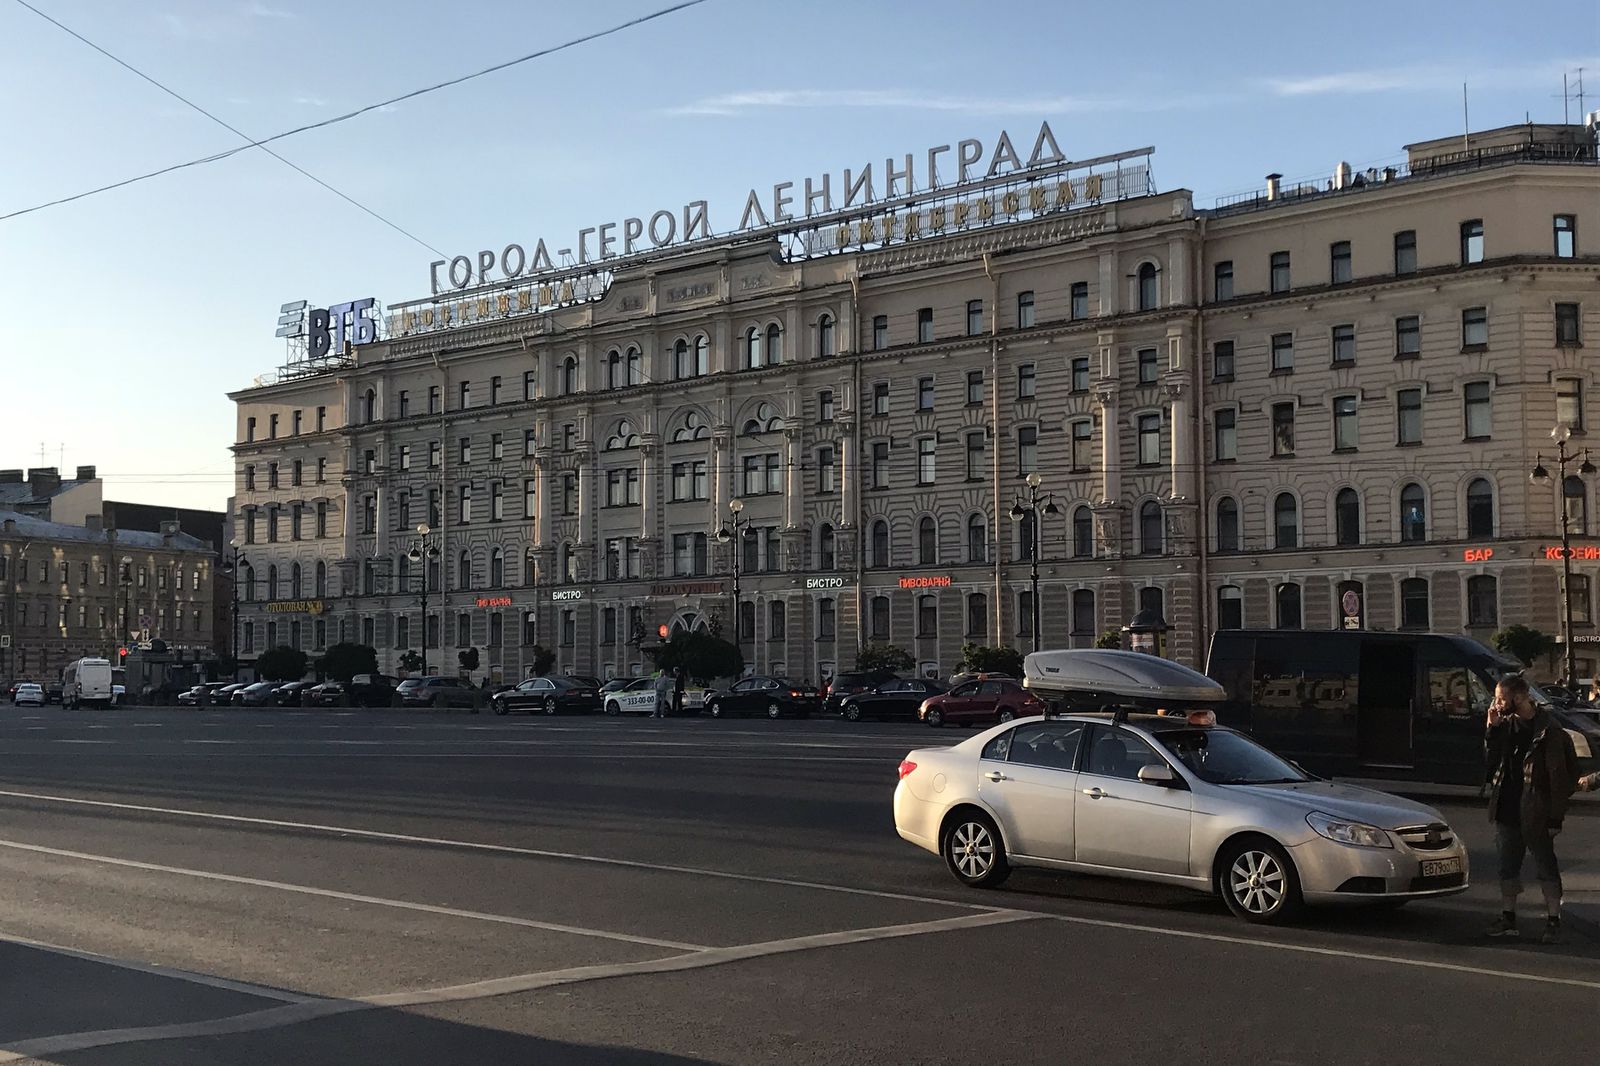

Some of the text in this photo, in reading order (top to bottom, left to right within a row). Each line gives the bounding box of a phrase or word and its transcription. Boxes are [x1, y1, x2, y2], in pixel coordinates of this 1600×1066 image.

[430, 121, 1068, 294] ГОРОД-ГЕРОЙ ЛЕНИНГРАД
[404, 174, 1103, 330] ГОСТИНИЦА ОКТЯБРЬСКАЯ
[308, 297, 375, 358] ВТБ
[1464, 548, 1494, 562] БАР
[806, 577, 843, 588] БИСТРО
[899, 576, 951, 588] ПИВОВАРНЯ
[552, 590, 581, 600] БИСТРО
[475, 597, 512, 608] ПИВВАРНЯ
[1573, 635, 1600, 643] BISTRO
[627, 695, 655, 705] 333-00-00
